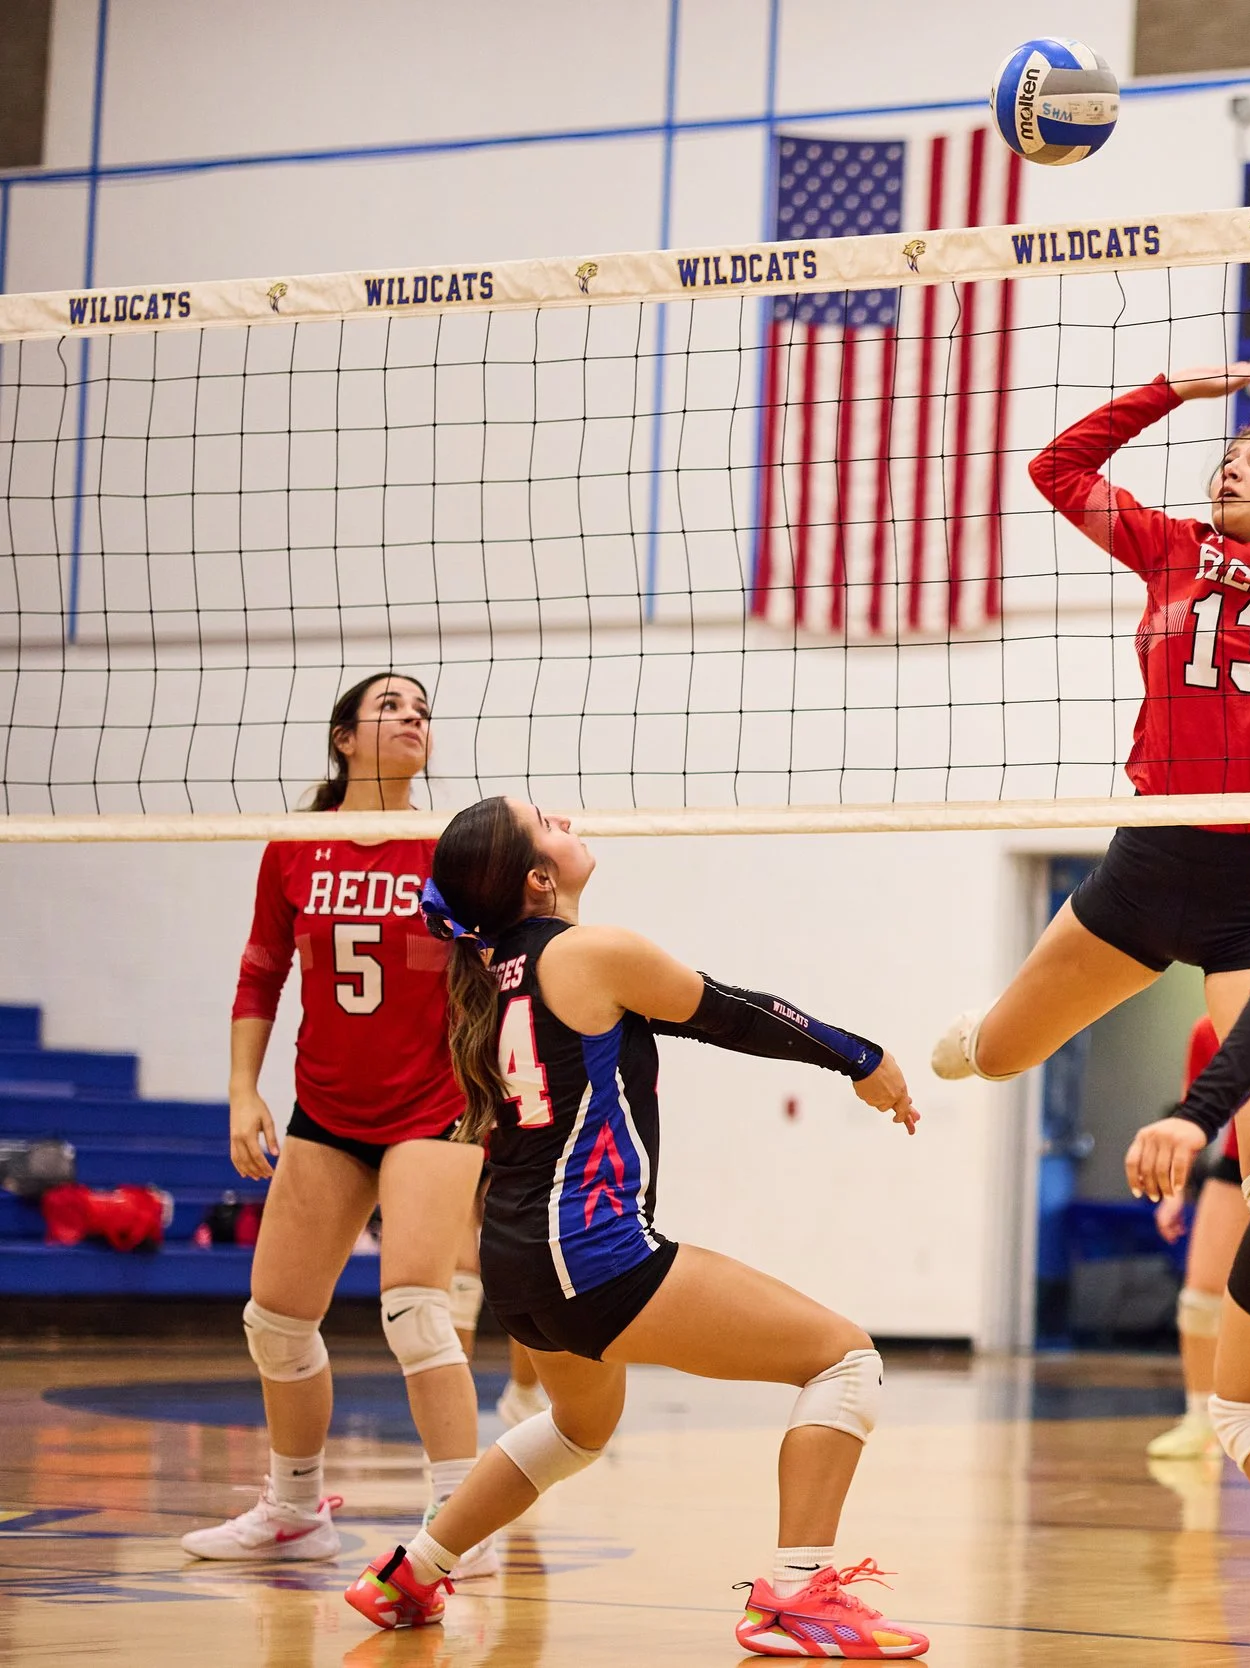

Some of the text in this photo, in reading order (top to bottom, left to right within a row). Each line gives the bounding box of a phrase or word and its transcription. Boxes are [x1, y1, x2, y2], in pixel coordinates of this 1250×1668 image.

[1018, 68, 1040, 140] molten
[1011, 224, 1161, 265] WILDCATS
[364, 270, 495, 307] WILDCATS
[676, 249, 818, 288] WILDCATS
[68, 290, 192, 326] WILDCATS
[303, 870, 422, 917] REDS
[332, 922, 384, 1016] 5
[772, 1000, 810, 1029] WILDCATS
